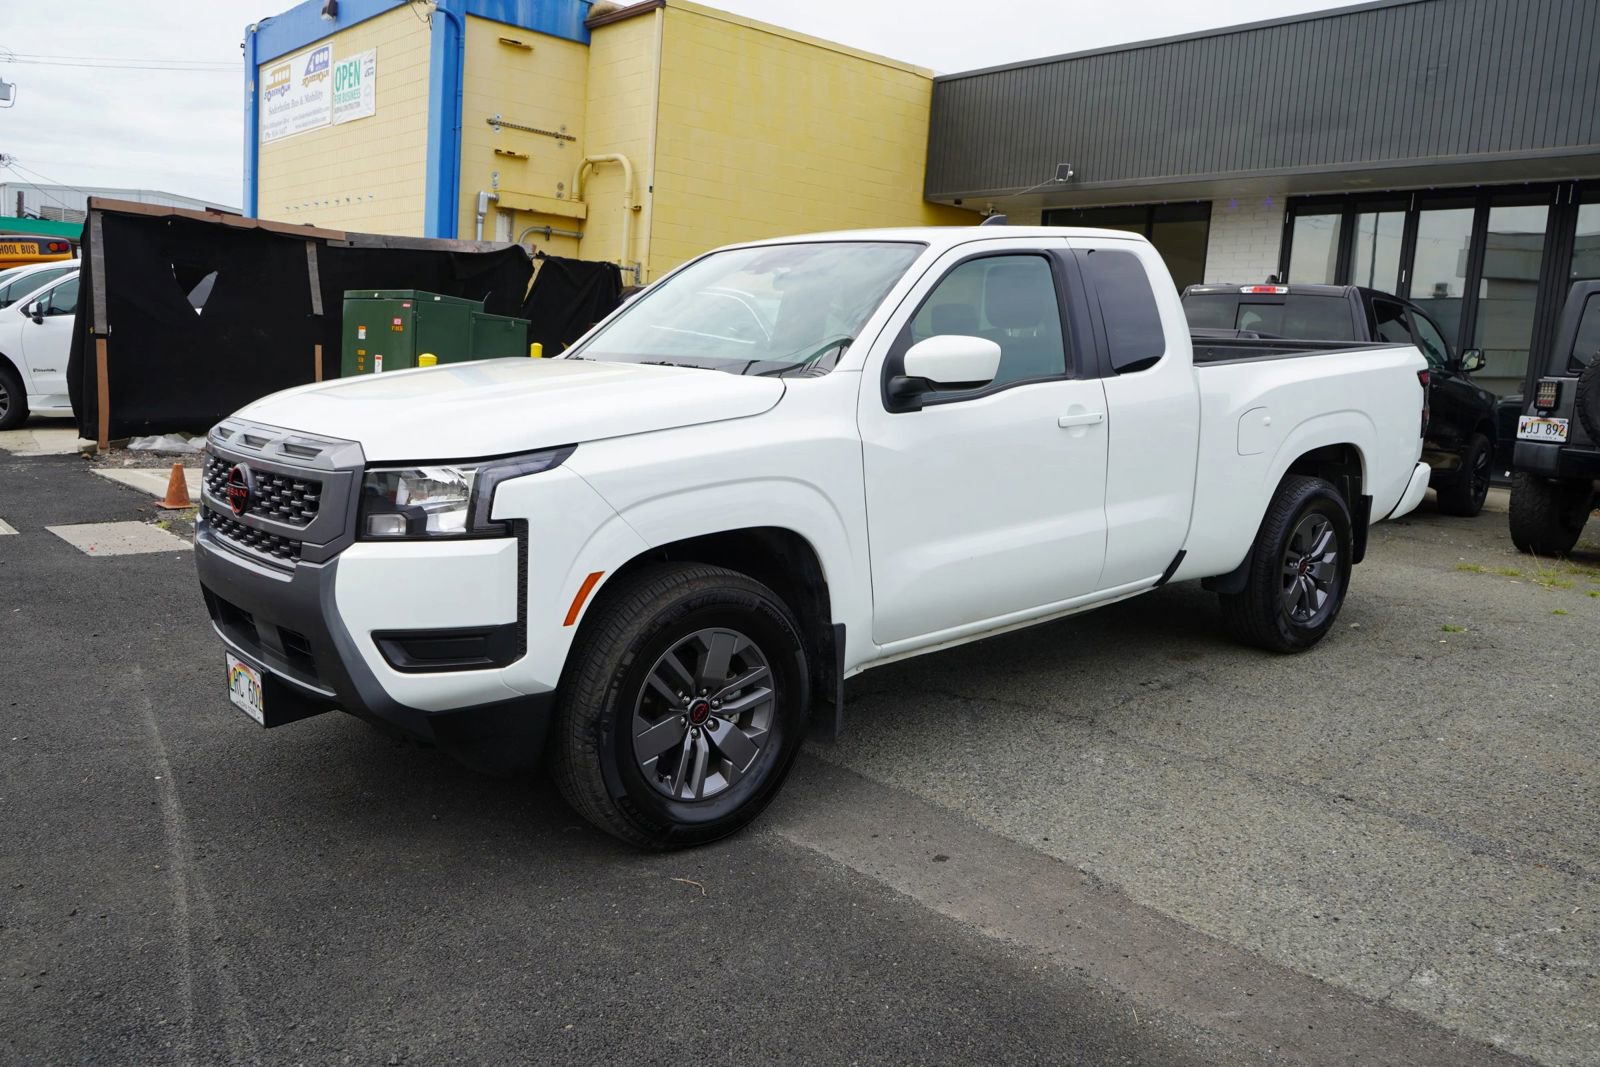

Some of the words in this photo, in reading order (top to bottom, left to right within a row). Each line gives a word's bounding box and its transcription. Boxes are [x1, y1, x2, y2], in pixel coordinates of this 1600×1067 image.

[335, 59, 361, 92] OPEN
[20, 244, 37, 255] BUS
[1520, 421, 1540, 434] WJJ
[1545, 423, 1566, 437] 892
